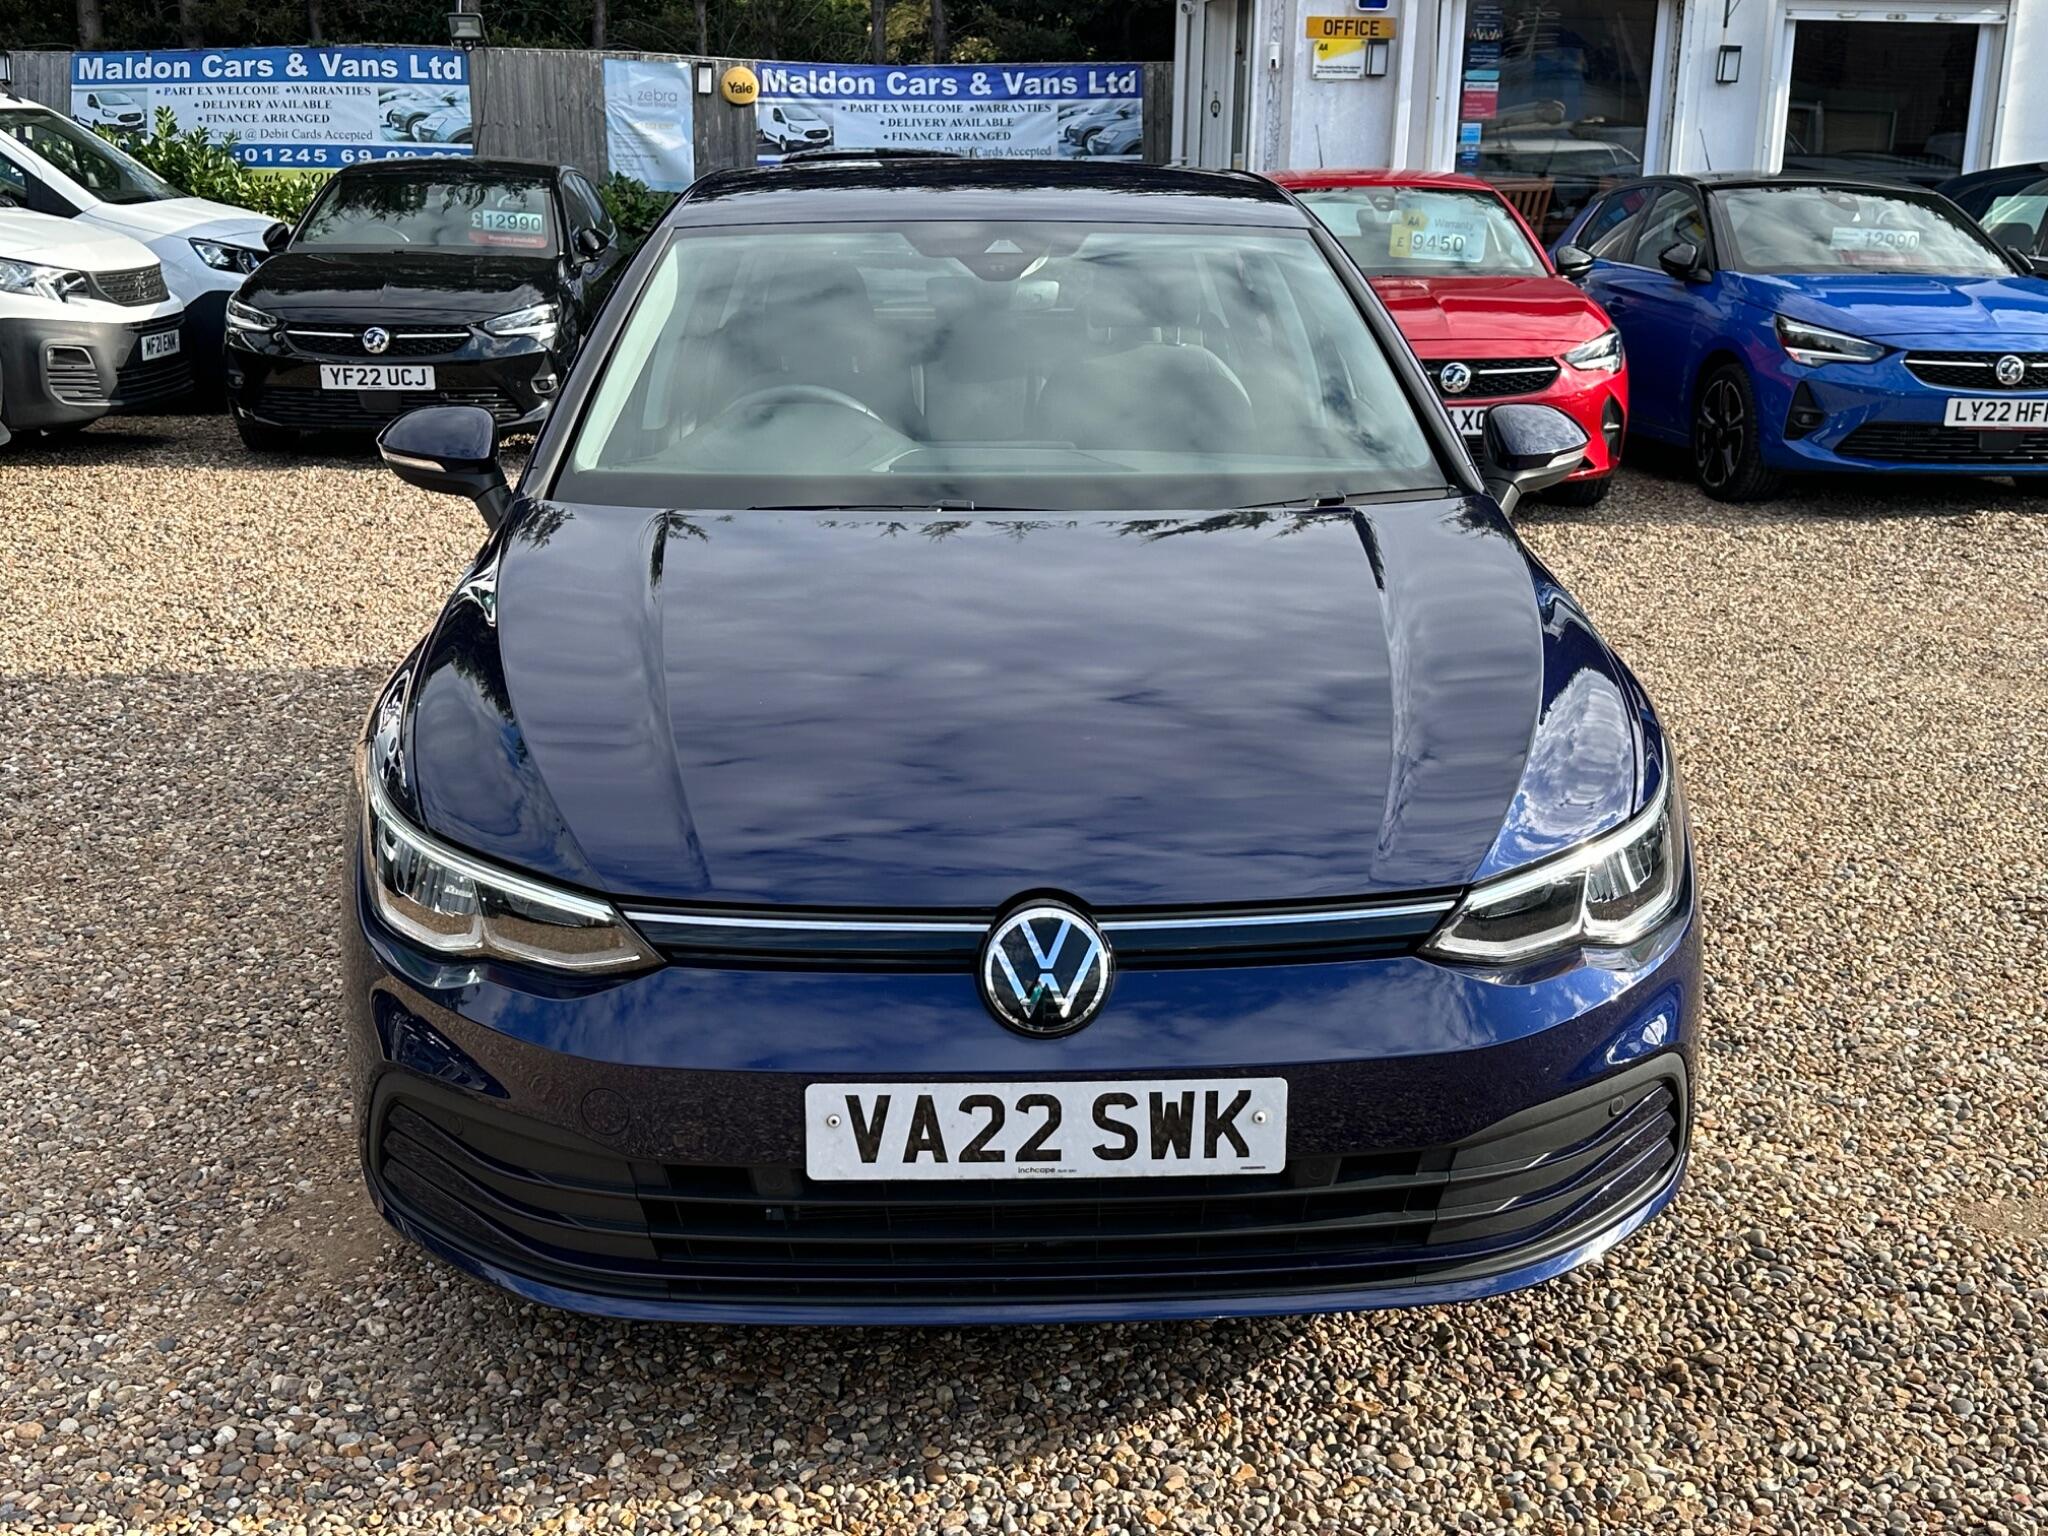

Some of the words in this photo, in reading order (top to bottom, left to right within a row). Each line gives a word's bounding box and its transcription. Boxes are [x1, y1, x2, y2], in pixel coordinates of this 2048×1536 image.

[1323, 19, 1380, 36] OFFICE
[78, 56, 191, 80] Maldon
[202, 54, 274, 78] Cars
[286, 53, 309, 77] &
[319, 54, 398, 77] Vans
[410, 54, 462, 79] Ltd
[728, 82, 753, 94] Yale
[761, 68, 875, 95] Maldon
[886, 71, 958, 96] Cars
[969, 72, 992, 96] &
[1002, 72, 1078, 96] Vans
[1088, 70, 1137, 94] Ltd
[164, 87, 194, 96] PART
[197, 87, 212, 96] EX
[217, 86, 279, 96] WELCOME
[291, 86, 371, 96] WARRANTIES
[638, 88, 678, 102] zebra
[203, 100, 262, 110] DELIVERY
[266, 100, 332, 110] AVAILABLE
[850, 104, 879, 113] PART
[883, 104, 898, 113] EX
[902, 104, 963, 113] WELCOME
[975, 104, 1052, 113] WARRANTIES
[206, 114, 259, 123] FINANCE
[262, 114, 330, 124] ARRANGED
[888, 118, 946, 128] DELIVERY
[950, 118, 1014, 128] AVAILABLE
[245, 128, 257, 141] @
[260, 129, 290, 140] Debit
[292, 129, 322, 140] Cards
[324, 130, 373, 142] Accepted
[892, 132, 943, 142] FINANCE
[947, 132, 1011, 142] ARRANGED
[340, 149, 372, 163] 69
[1006, 146, 1052, 159] Accepted
[1864, 231, 1918, 250] 12990
[329, 367, 382, 386] YF22
[387, 368, 427, 386] UCJ
[1955, 401, 2011, 422] LY22
[845, 1093, 1063, 1164] VA22
[1092, 1090, 1253, 1162] SWK
[1017, 1166, 1056, 1175] inchcape
